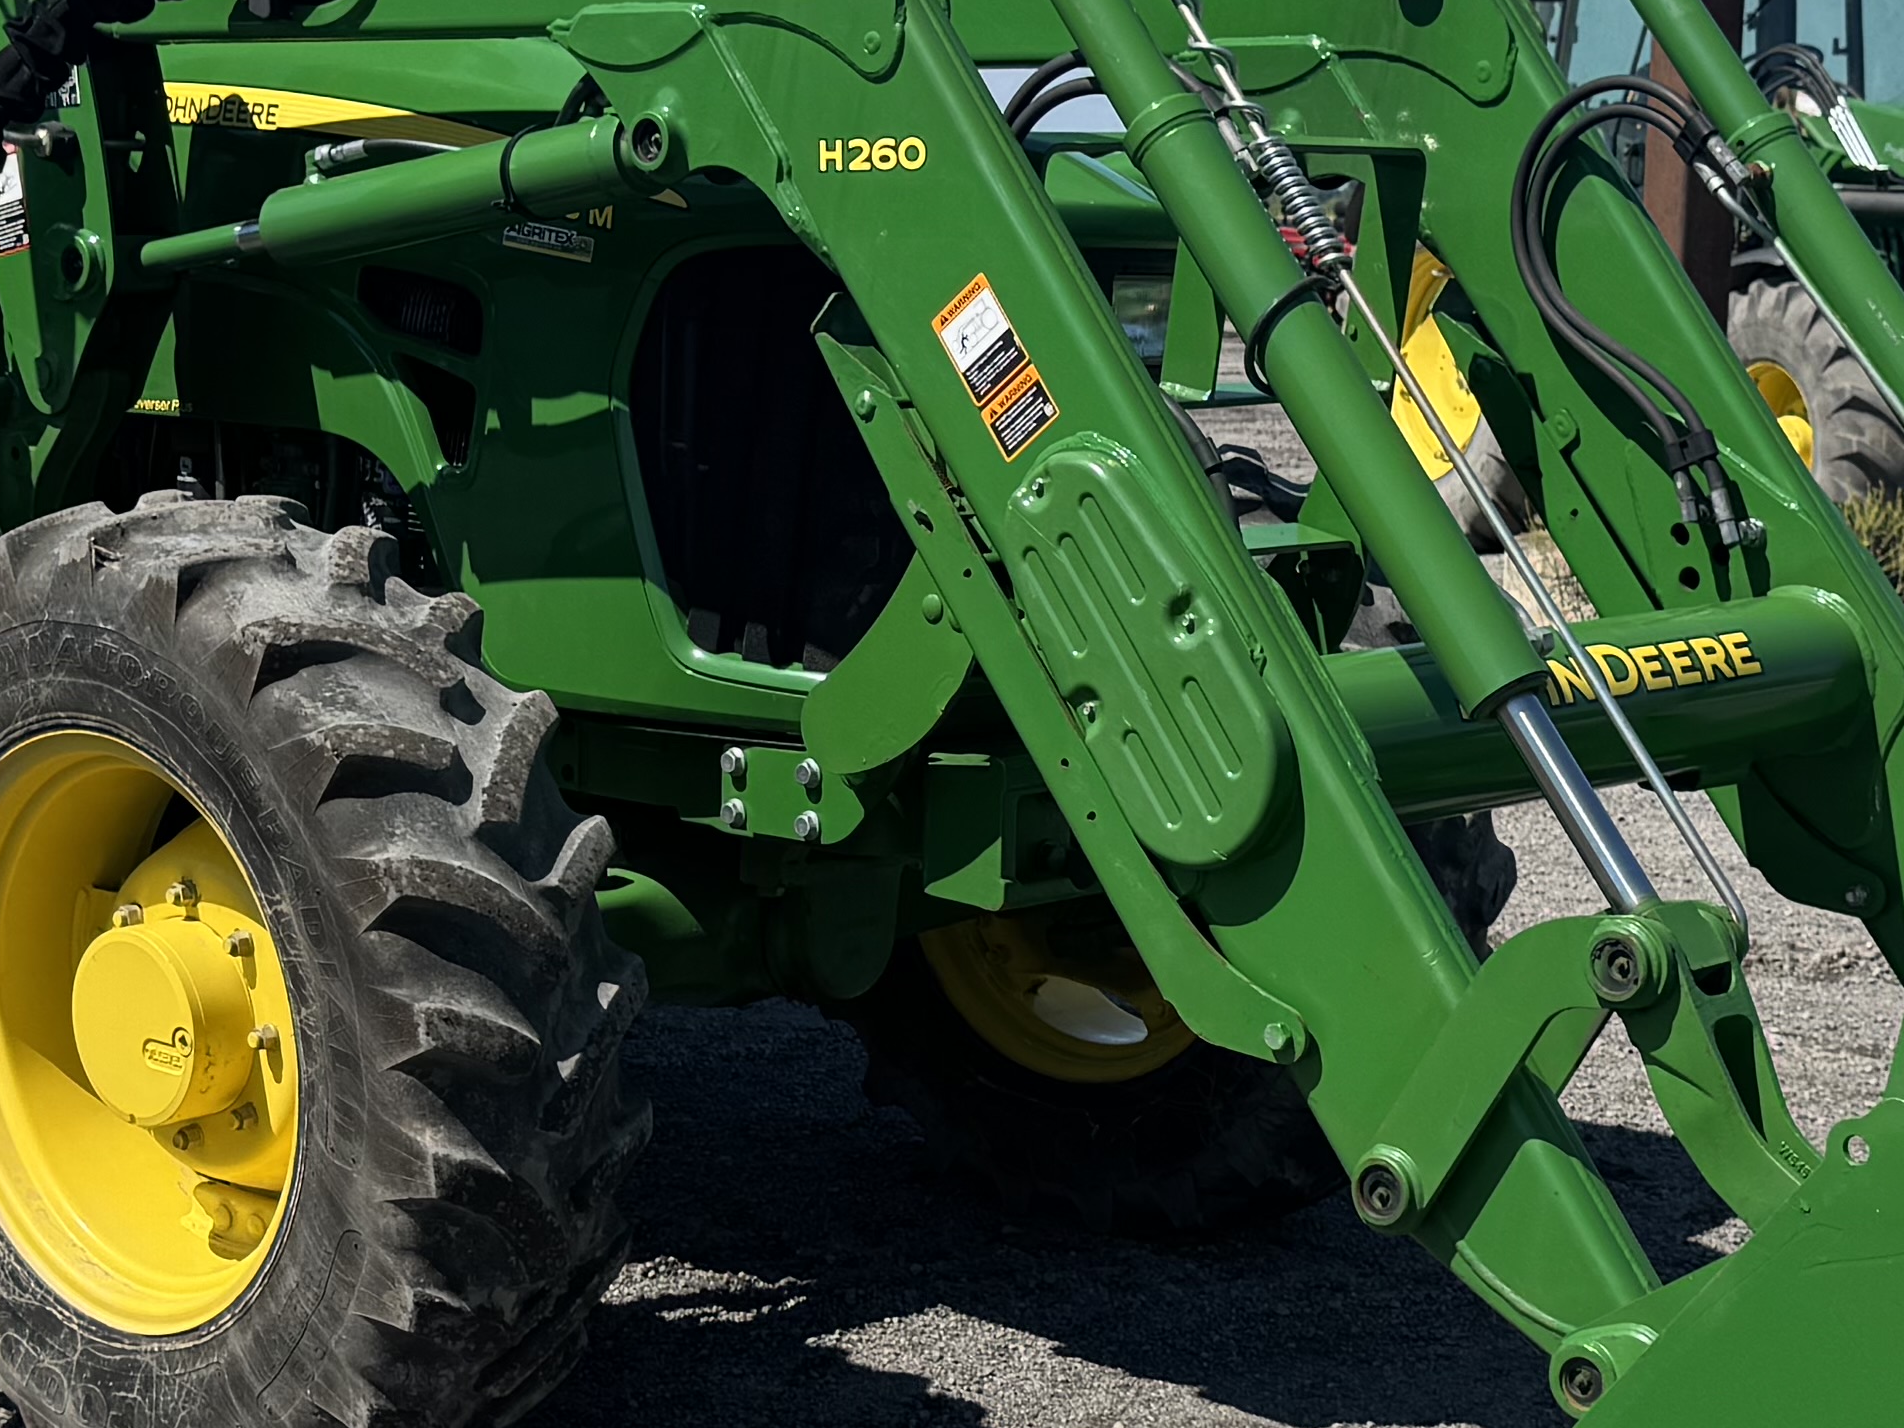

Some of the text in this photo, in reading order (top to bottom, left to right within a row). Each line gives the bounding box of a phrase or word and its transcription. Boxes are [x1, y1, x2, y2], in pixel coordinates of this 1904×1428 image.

[205, 93, 279, 125] DEERE
[818, 136, 927, 172] H260
[506, 222, 577, 247] AGRITEX
[588, 204, 614, 230] M
[948, 281, 982, 318] WARNING
[997, 373, 1034, 409] WARNING
[1585, 631, 1763, 697] DEERE
